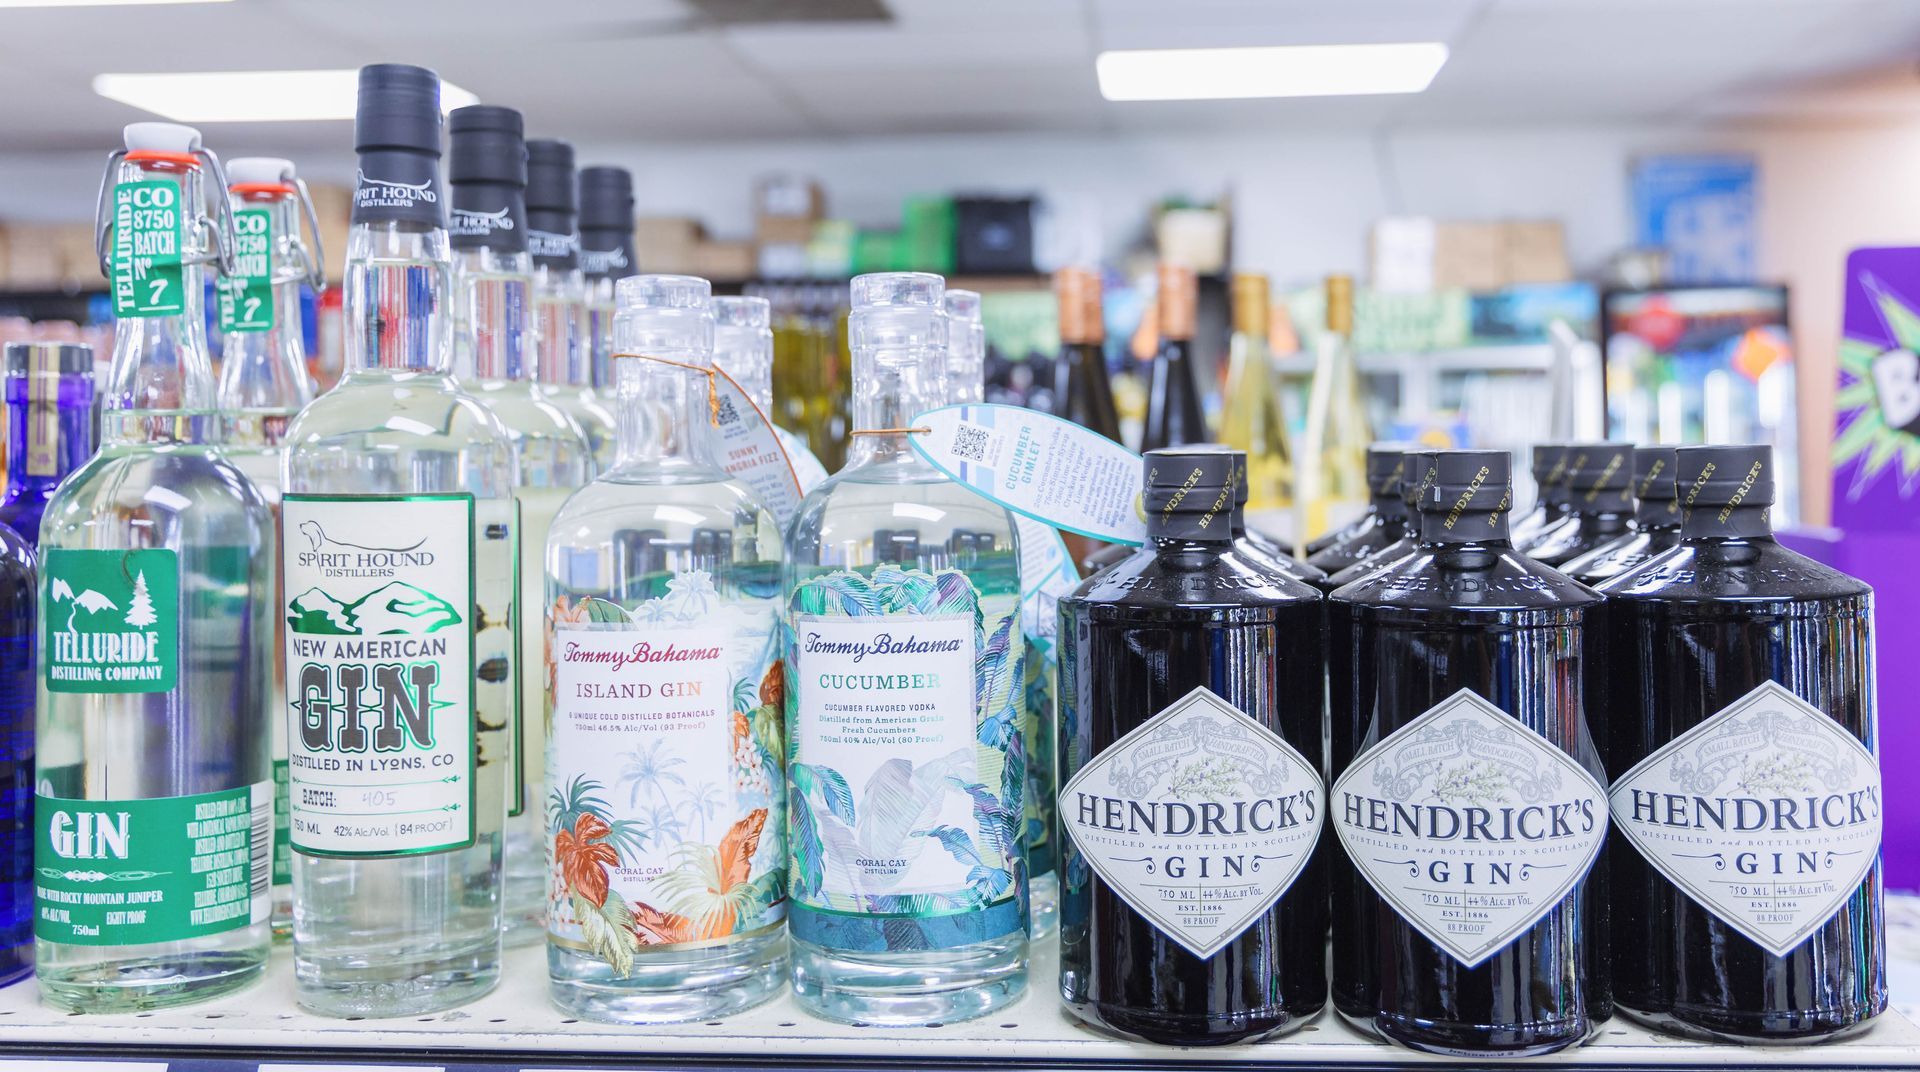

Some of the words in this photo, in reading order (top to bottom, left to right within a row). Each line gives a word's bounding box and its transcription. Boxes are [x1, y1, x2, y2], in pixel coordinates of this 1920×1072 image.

[133, 187, 174, 207] CO
[361, 199, 413, 208] DISTILLERS
[383, 187, 436, 203] HOUND
[133, 209, 175, 229] 8750
[116, 188, 135, 312] TELLURIDE
[134, 231, 175, 255] BATCH
[149, 279, 168, 306] 7
[244, 298, 261, 322] 7
[728, 444, 759, 461] SUNNY
[1005, 426, 1033, 490] CUCUMBER
[1020, 440, 1041, 484] GIMLET
[1444, 466, 1489, 530] HENDRICK'S
[1718, 460, 1762, 524] HENDRICK'S
[298, 551, 351, 568] SPIRIT
[357, 552, 434, 567] HOUND
[325, 568, 394, 577] DISTILLERS
[53, 631, 159, 663] TELLURIDE
[293, 639, 326, 657] NEW
[334, 638, 446, 659] AMERICAN
[805, 632, 871, 663] Tommy
[867, 633, 960, 655] Bahama
[564, 641, 630, 671] Tommy
[627, 641, 720, 663] Bahama
[51, 666, 102, 680] DISTILLING
[105, 665, 163, 680] COMPANY
[576, 683, 651, 699] ISLAND
[660, 681, 702, 699] GIN
[819, 674, 941, 690] CUCUMBER
[299, 660, 439, 754] GIN
[574, 712, 597, 720] UNIQUE
[599, 713, 619, 721] COLD
[621, 713, 663, 721] DISTILLED
[666, 709, 715, 720] BOTANICALS
[824, 703, 863, 713] CUCUMBER
[865, 704, 906, 713] FLAVORED
[909, 703, 936, 711] VODKA
[598, 724, 622, 732] 46.5%
[624, 724, 658, 732] Alc/Vol
[660, 723, 675, 732] (93
[677, 721, 706, 730] Proof)
[819, 715, 850, 724] Distilled
[852, 715, 872, 724] from
[875, 715, 917, 724] American
[842, 726, 865, 734] Fresh
[867, 726, 916, 734] Cucumbers
[819, 735, 842, 744] 750ml
[843, 736, 860, 744] 40%
[862, 736, 895, 746] Alc/Vol
[898, 735, 913, 745] (80
[292, 754, 340, 770] DISTILLED
[346, 759, 363, 771] IN
[432, 754, 454, 767] CO
[303, 789, 337, 807] BATCH:
[1077, 790, 1315, 836] HENDRICK'S
[1344, 792, 1594, 842] HENDRICK'S
[1630, 785, 1879, 832] HENDRICK'S
[50, 810, 131, 859] GIN
[307, 822, 321, 835] ML
[334, 825, 352, 837] 42%
[395, 822, 413, 837] (84
[415, 818, 453, 833] PROOF)
[1642, 830, 1713, 844] DISTILLED
[1837, 827, 1878, 841] SCOTLAND
[1085, 833, 1145, 849] DISTILLED
[1264, 830, 1313, 846] SCOTLAND
[1350, 834, 1408, 851] DISTILLED
[1534, 841, 1589, 855] SCOTLAND
[614, 867, 644, 875] CORAL
[646, 867, 664, 875] CAY
[856, 859, 886, 867] CORAL
[888, 859, 907, 867] CAY
[1164, 855, 1245, 879] GIN
[1736, 852, 1818, 874] GIN
[1428, 861, 1512, 884] GIN
[60, 891, 82, 904] ROCKY
[83, 892, 125, 905] MOUNTAIN
[126, 890, 163, 905] JUNIPER
[1159, 889, 1175, 899] 750
[1180, 890, 1195, 899] ML
[1753, 887, 1769, 896] ML
[1444, 896, 1460, 905] ML
[106, 911, 127, 925] EIGHTY
[128, 910, 147, 924] PROOF
[1194, 917, 1219, 925] PROOF
[1442, 910, 1463, 918] EST.
[1768, 914, 1793, 922] PROOF
[72, 925, 100, 936] 750ml
[1458, 924, 1485, 932] PROOF
